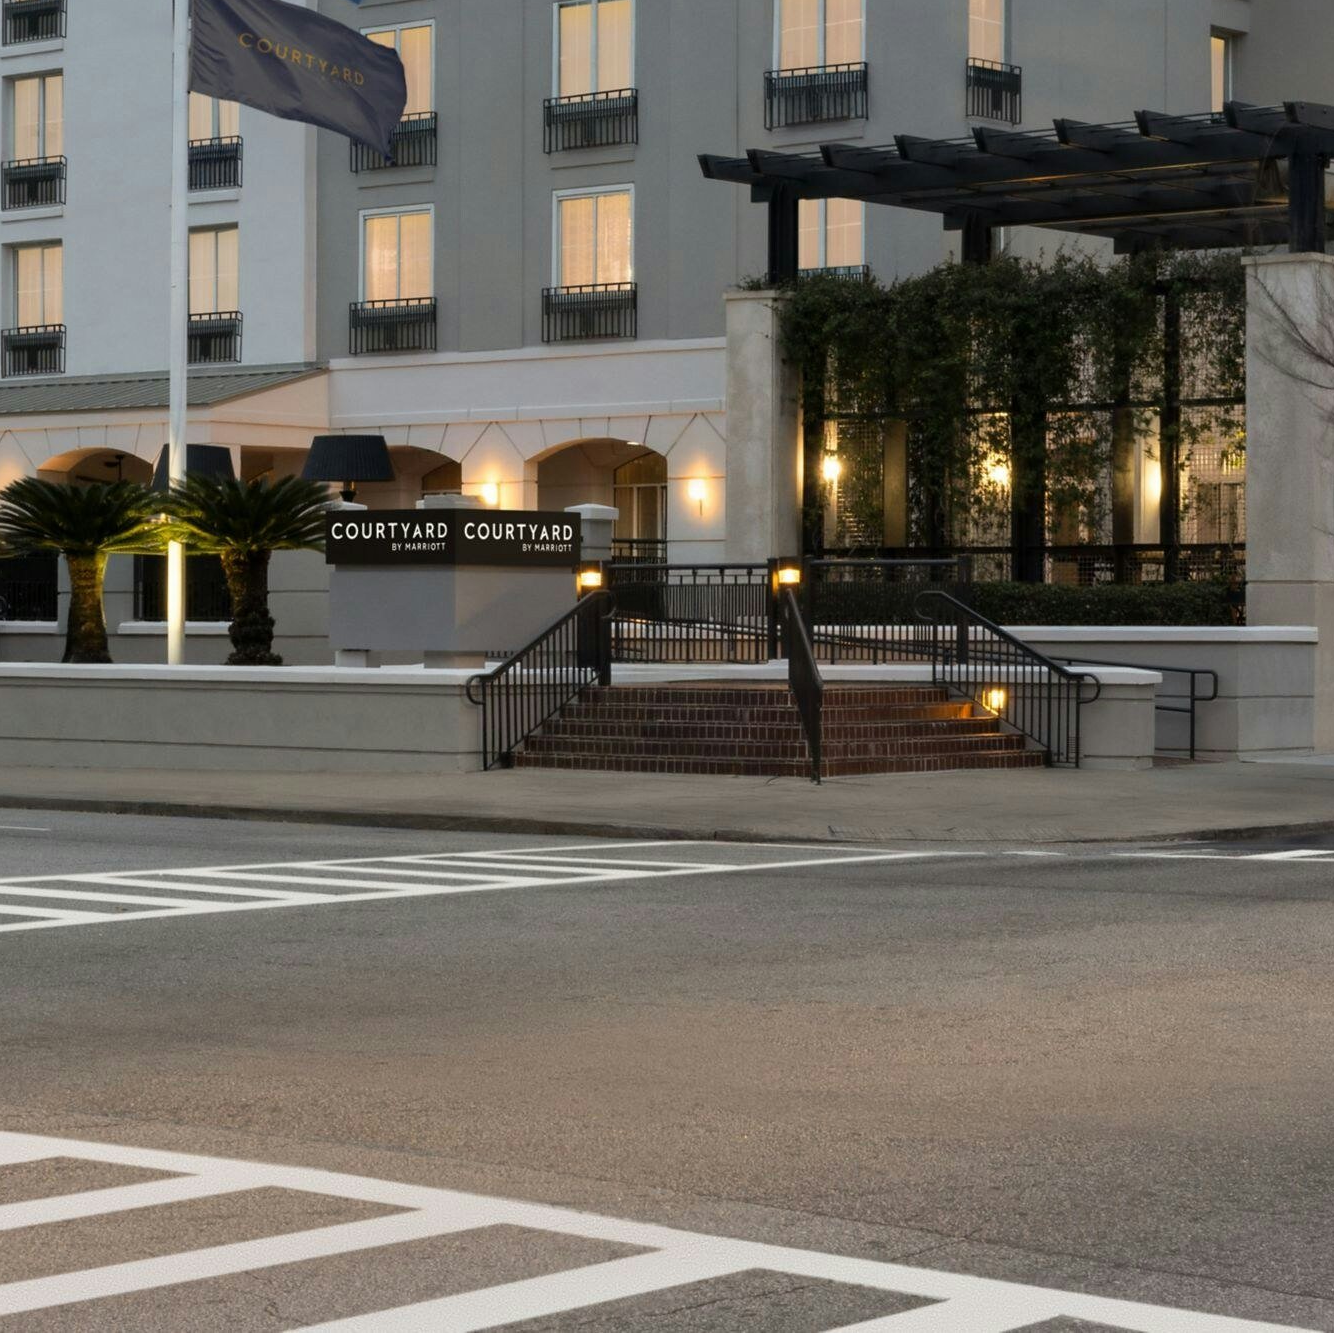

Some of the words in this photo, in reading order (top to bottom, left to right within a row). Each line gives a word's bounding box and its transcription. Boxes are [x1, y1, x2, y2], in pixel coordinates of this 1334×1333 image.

[237, 32, 365, 86] COURTYARD
[331, 522, 448, 540] COURTYARD
[464, 522, 573, 541] COURTYARD
[391, 542, 402, 551] BY
[404, 542, 446, 551] MARRIOTT
[522, 544, 532, 552] BY
[534, 544, 572, 552] MARRIOTT
